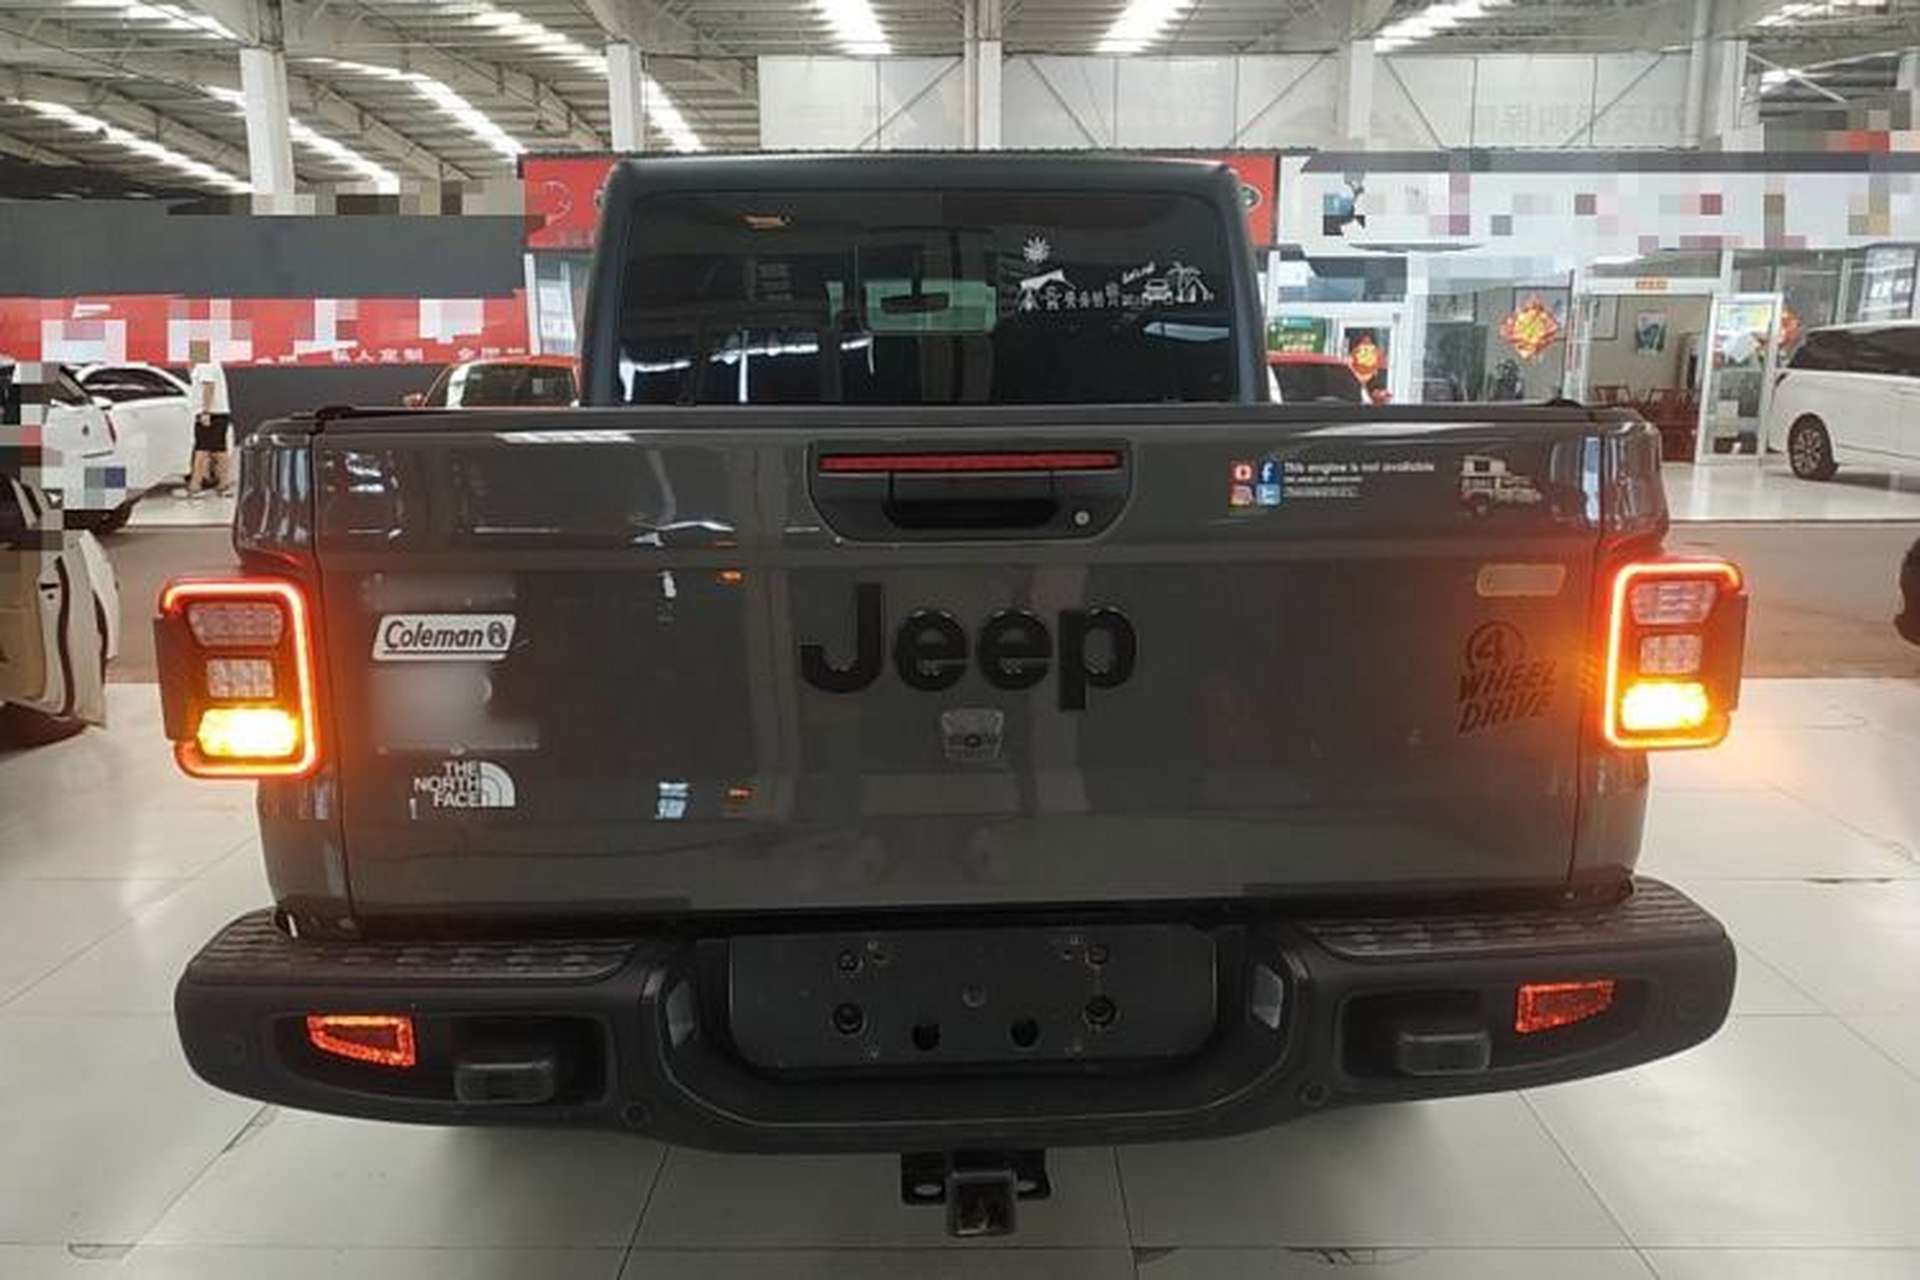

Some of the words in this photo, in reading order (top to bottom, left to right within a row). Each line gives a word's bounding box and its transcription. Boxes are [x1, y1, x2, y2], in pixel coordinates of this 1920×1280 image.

[1284, 462, 1304, 473] This
[1308, 463, 1347, 475] engine
[1350, 462, 1358, 473] is
[1362, 462, 1379, 472] not
[1382, 462, 1435, 472] available
[384, 621, 484, 648] Coleman
[799, 583, 1137, 712] Jeep
[1459, 659, 1557, 702] WHEEL
[1457, 691, 1553, 735] DRIVE
[445, 761, 480, 777] THE
[414, 776, 480, 792] NORTH
[434, 791, 479, 807] FACE
